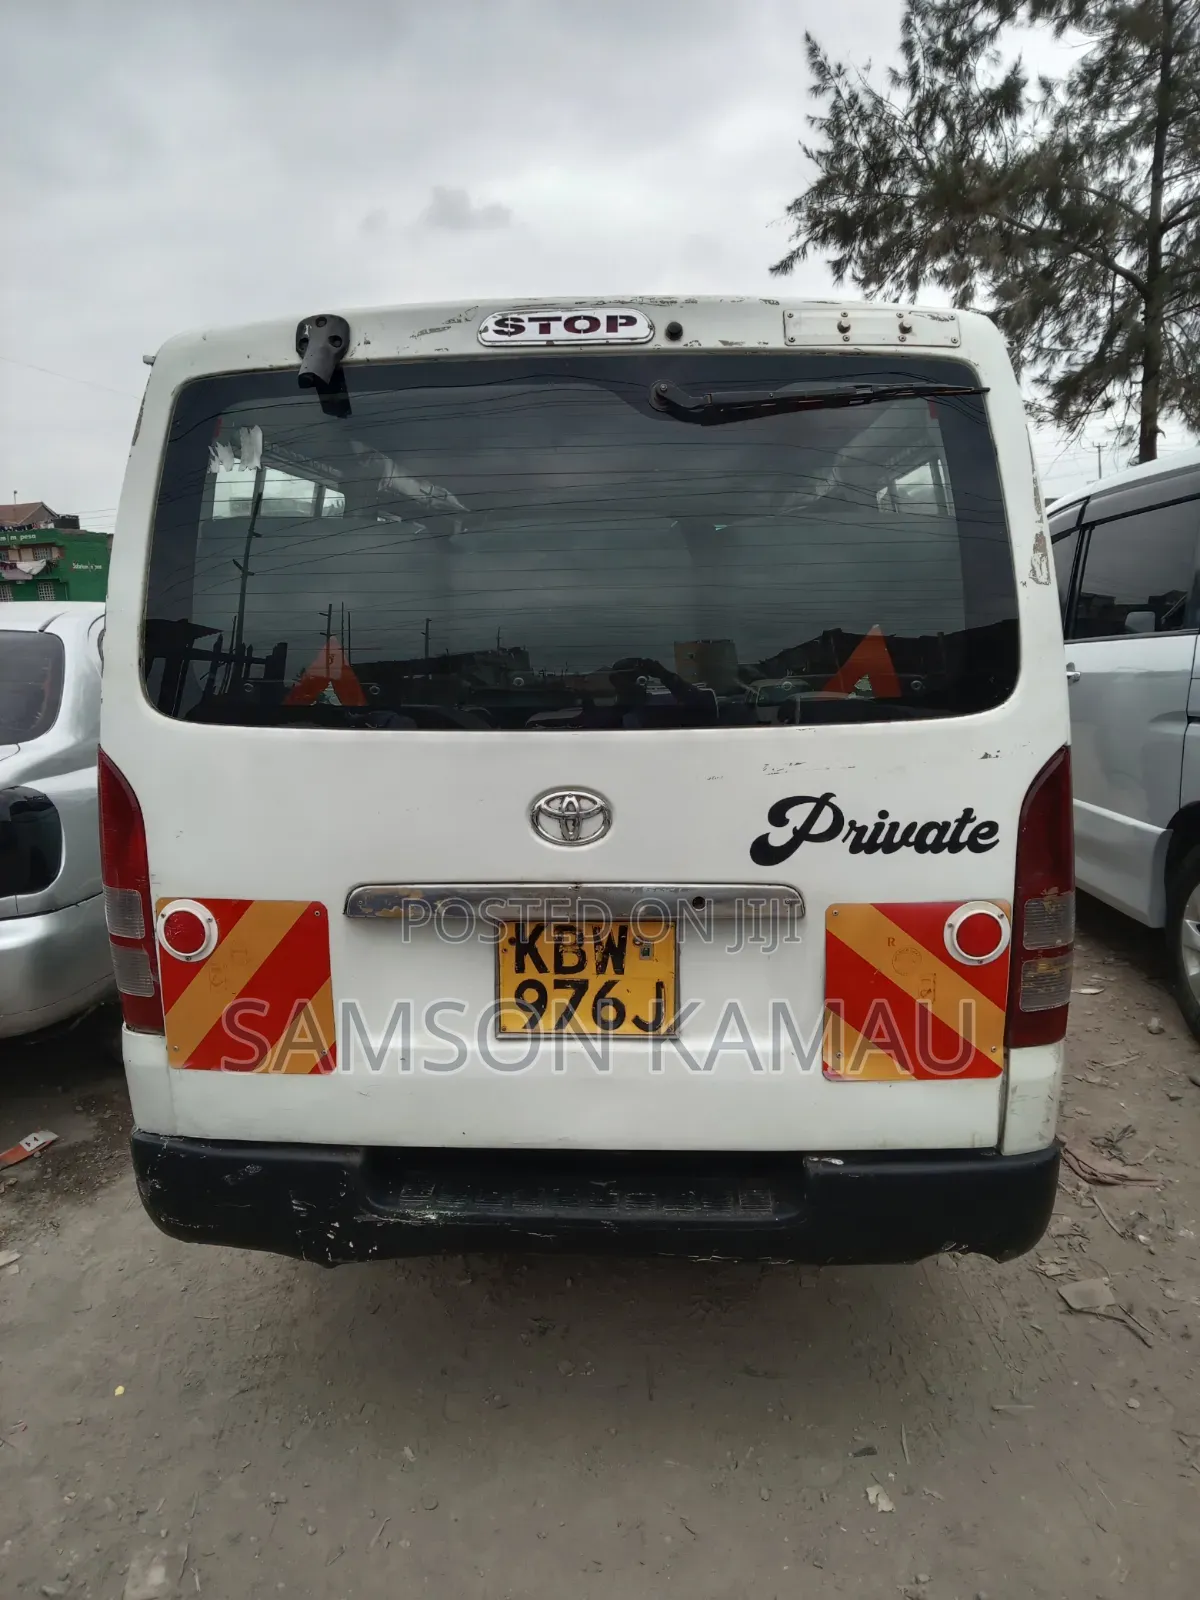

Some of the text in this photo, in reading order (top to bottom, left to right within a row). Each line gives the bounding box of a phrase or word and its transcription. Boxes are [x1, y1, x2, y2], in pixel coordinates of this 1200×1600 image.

[492, 315, 638, 336] STOP
[750, 792, 1000, 867] Private
[514, 923, 628, 975] KBW
[887, 937, 896, 947] R
[514, 979, 666, 1031] 976J
